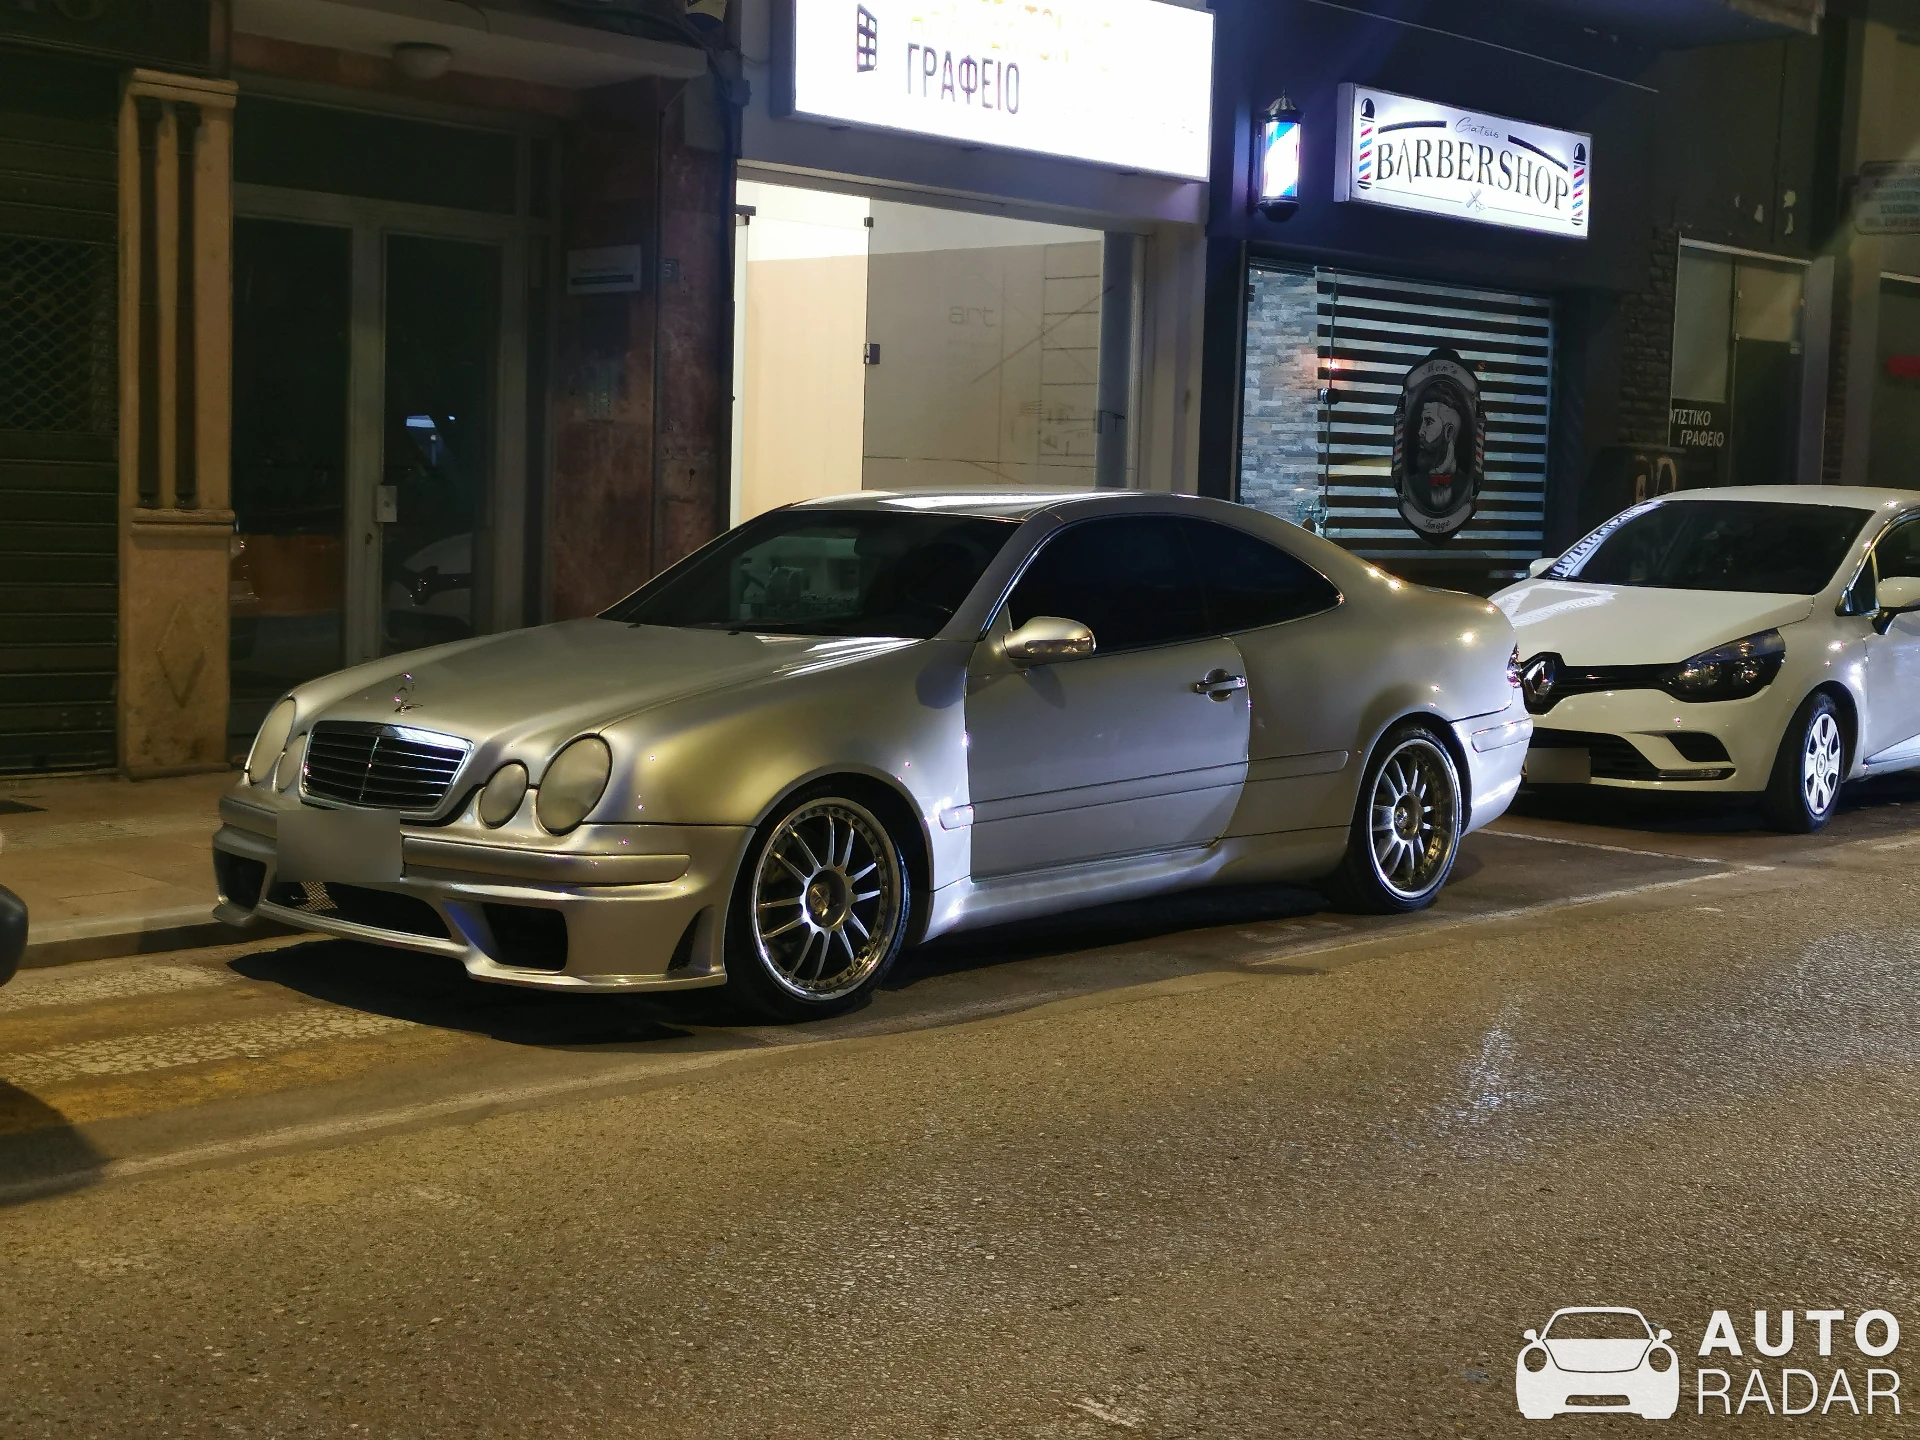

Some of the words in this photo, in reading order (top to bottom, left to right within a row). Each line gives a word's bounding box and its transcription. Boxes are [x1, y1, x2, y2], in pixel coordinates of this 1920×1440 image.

[906, 42, 1020, 116] ΓΡΑΦΕΙΟ
[1376, 138, 1569, 210] BARBERSHOP
[1680, 429, 1725, 448] ΓΡΑΦΕΙΟ
